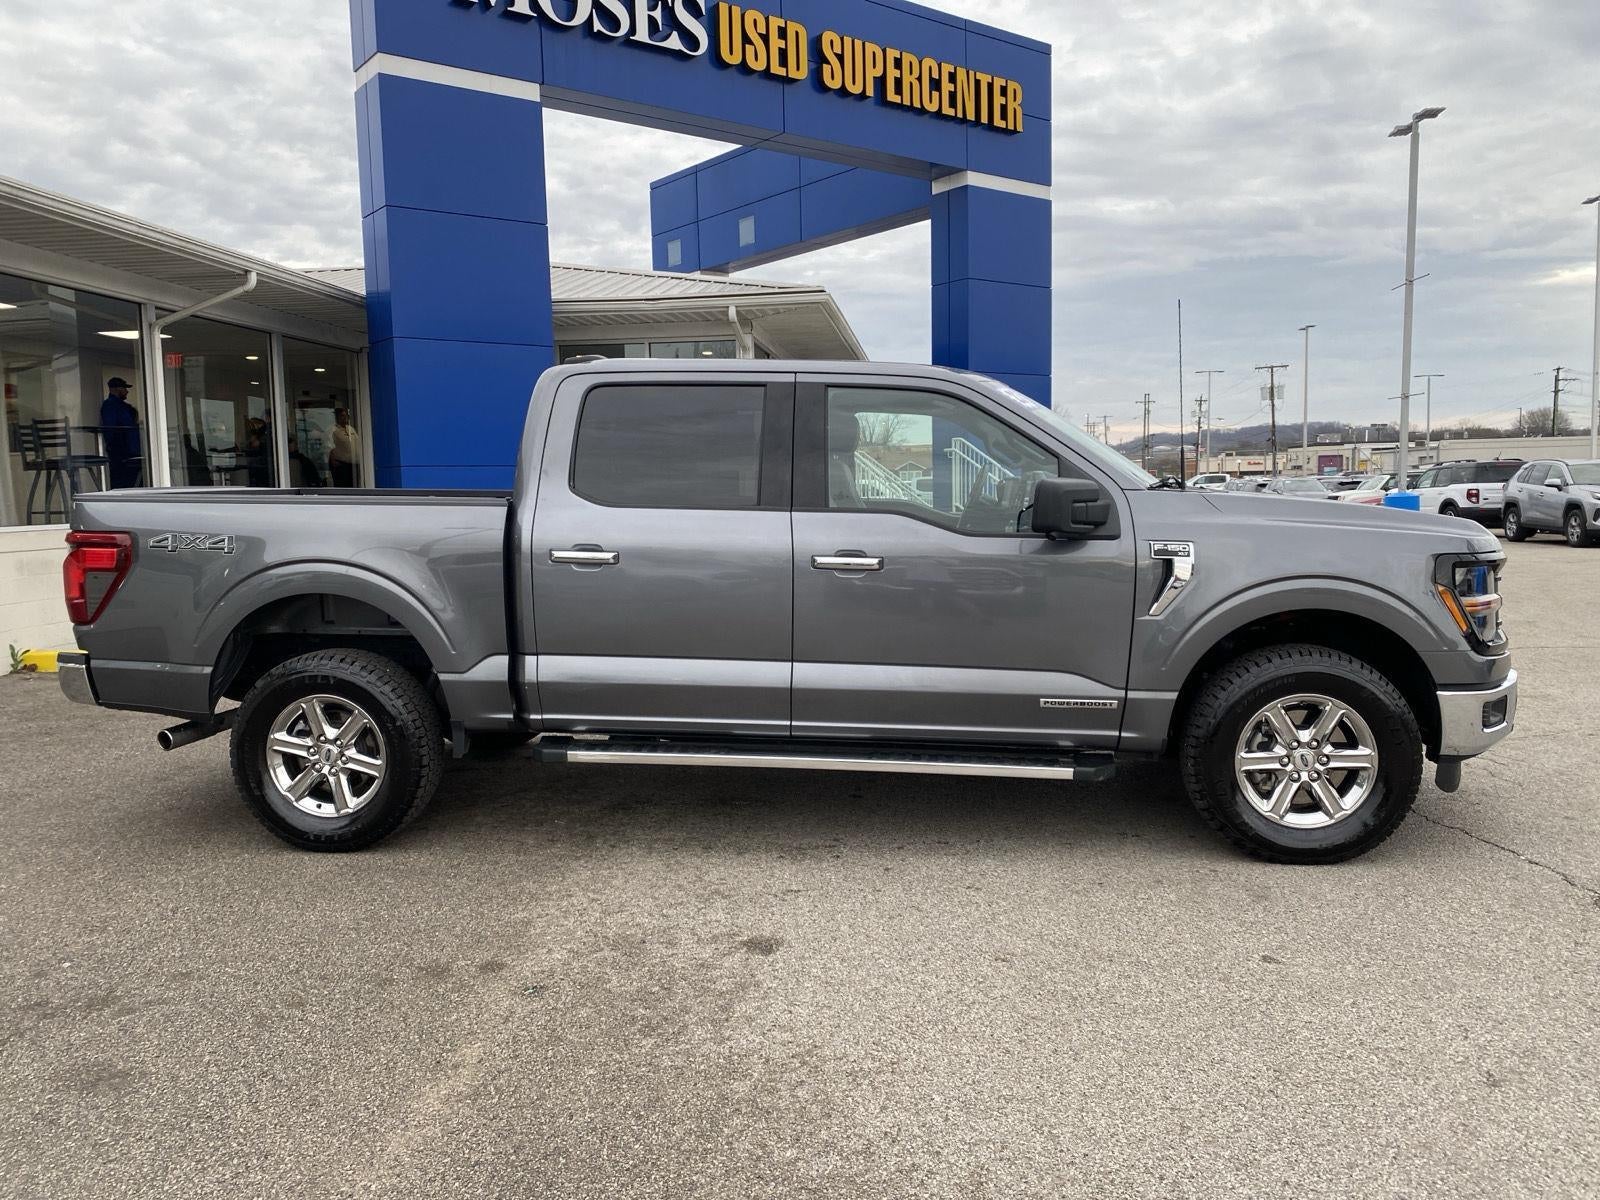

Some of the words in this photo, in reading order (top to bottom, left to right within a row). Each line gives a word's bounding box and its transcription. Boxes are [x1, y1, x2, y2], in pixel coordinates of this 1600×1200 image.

[468, 0, 709, 56] OSES
[717, 1, 808, 80] USED
[820, 29, 1024, 133] SUPERCENTER
